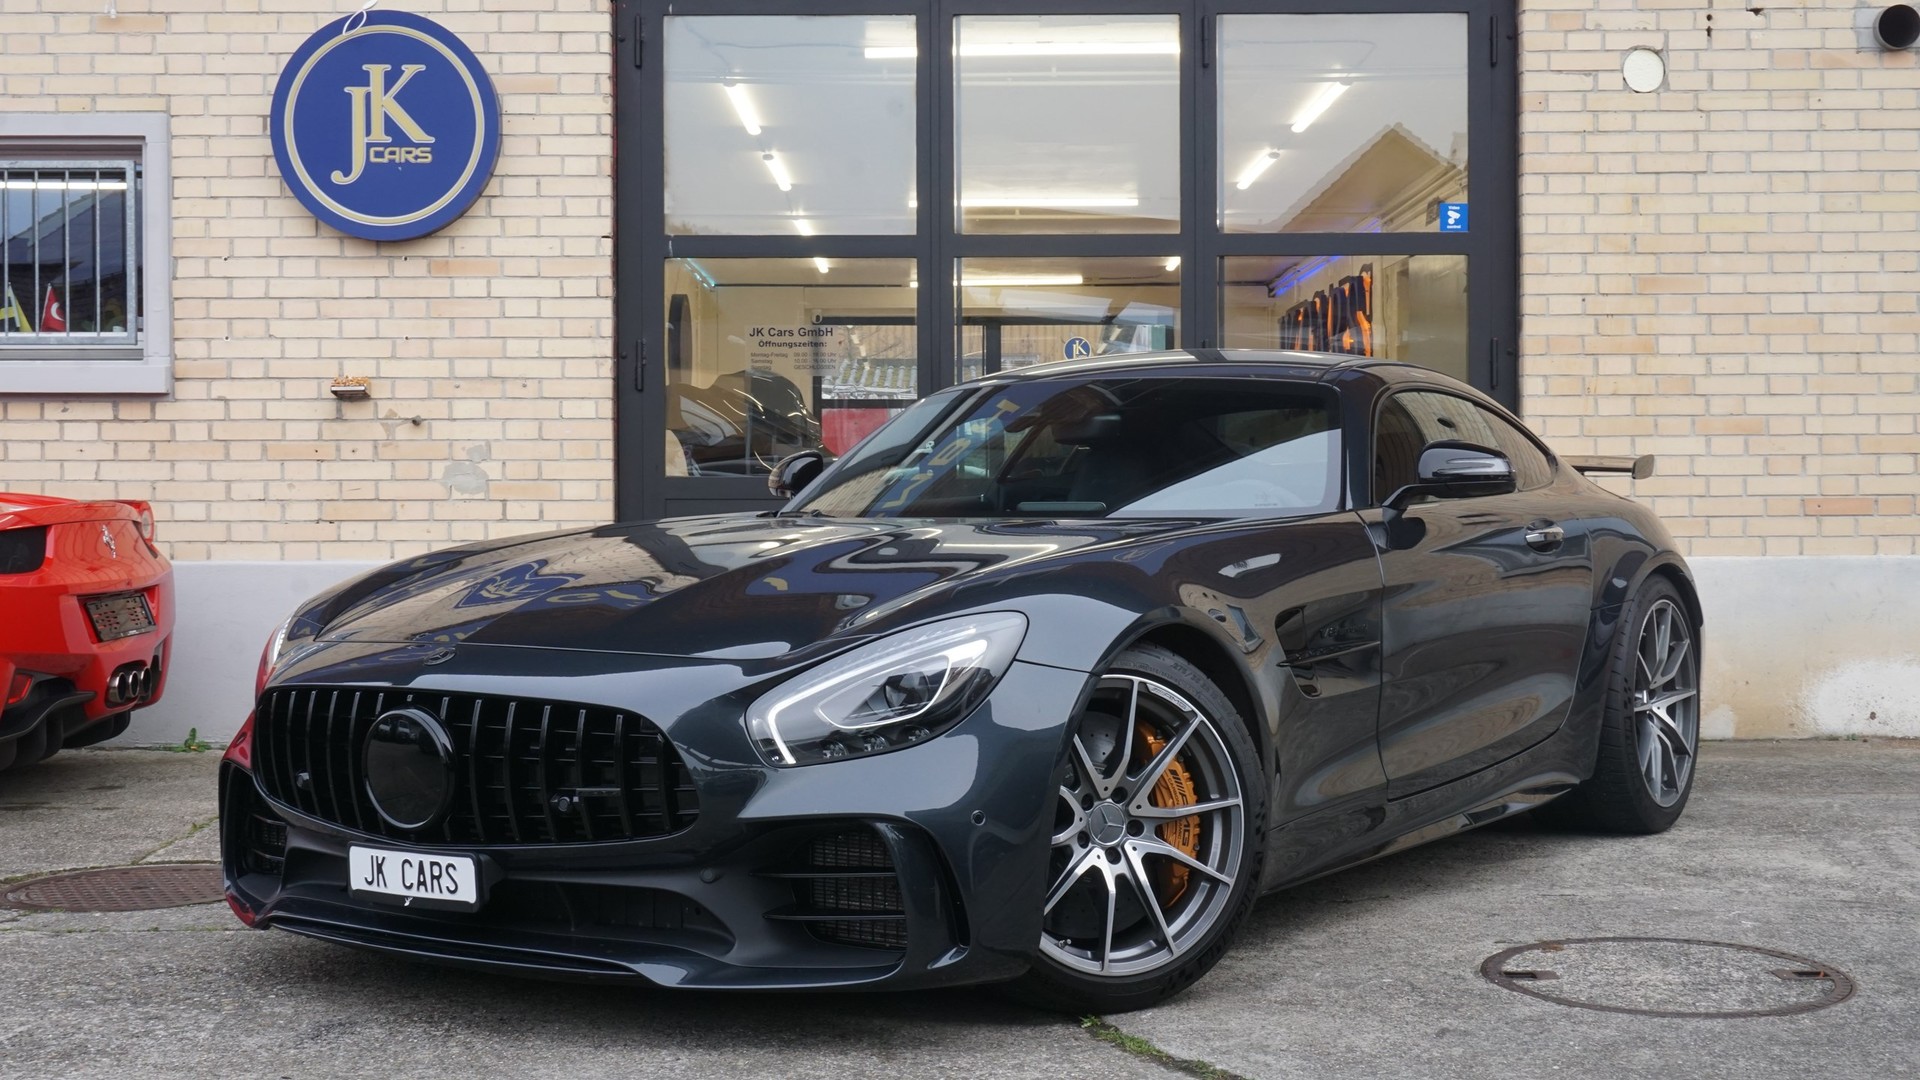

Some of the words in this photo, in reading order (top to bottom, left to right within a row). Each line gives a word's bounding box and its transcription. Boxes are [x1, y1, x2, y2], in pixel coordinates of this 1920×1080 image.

[331, 64, 435, 185] JK
[369, 147, 433, 163] CARS
[749, 327, 764, 337] JK
[768, 327, 794, 337] Cars
[798, 327, 833, 337] GmbH
[758, 339, 828, 348] Öffnungszeiten:
[1168, 778, 1180, 805] CARBON
[364, 854, 388, 888] JK
[401, 858, 458, 894] CARS
